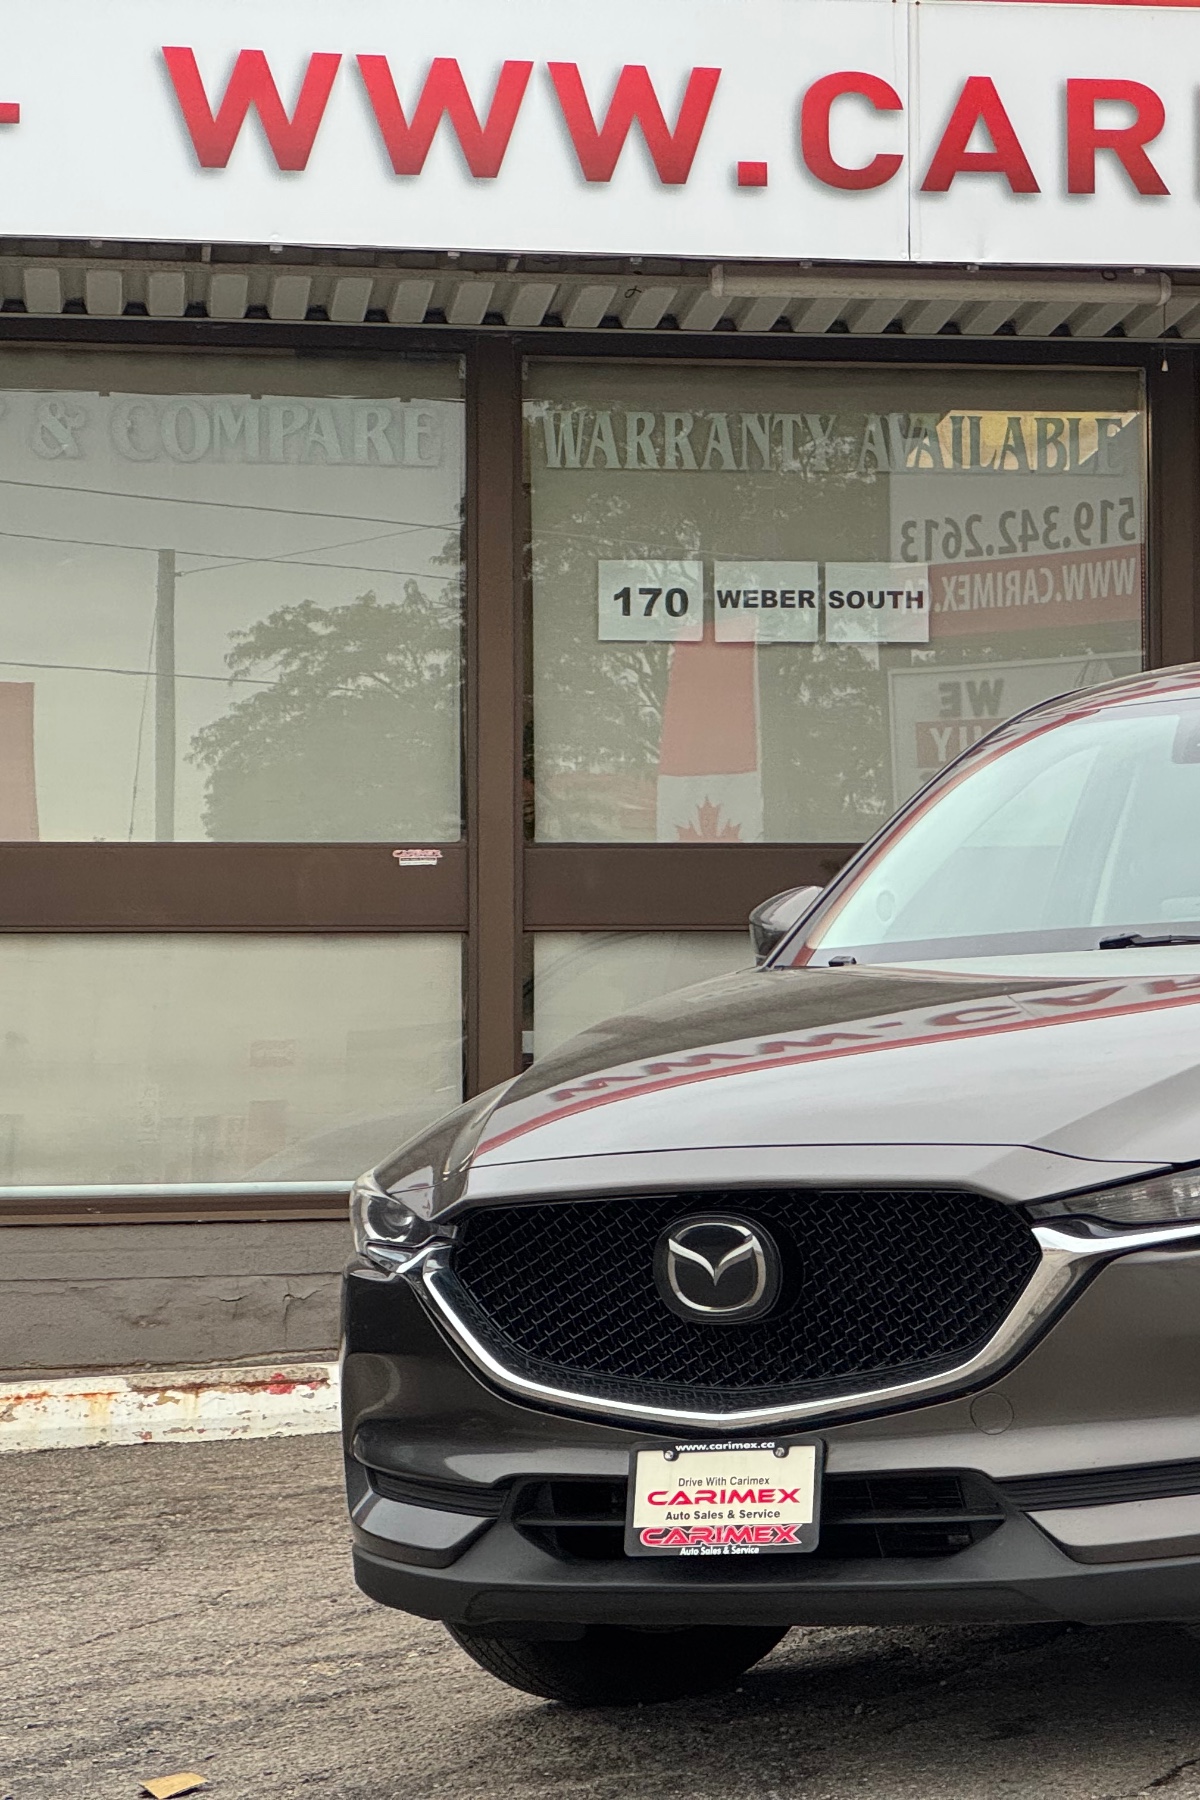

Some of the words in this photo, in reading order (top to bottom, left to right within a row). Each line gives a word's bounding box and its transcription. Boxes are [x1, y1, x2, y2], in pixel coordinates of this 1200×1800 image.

[110, 398, 442, 467] COMPARE
[543, 409, 838, 471] WARRANTY
[858, 411, 1124, 475] AVAILABLE
[613, 587, 690, 618] 170
[716, 589, 817, 609] WEBER
[828, 589, 925, 610] SOUTH
[675, 1441, 775, 1452] www.carimex.ca
[678, 1476, 703, 1487] Drive
[706, 1476, 727, 1487] With
[730, 1475, 770, 1486] Carimex
[647, 1488, 801, 1505] CARIMEX
[665, 1511, 691, 1521] Auto
[694, 1510, 724, 1520] Sales
[727, 1511, 735, 1519] &
[739, 1509, 781, 1519] Service
[640, 1524, 802, 1546] CARIMEX
[680, 1547, 699, 1555] Auto
[701, 1546, 722, 1556] Sales
[724, 1547, 730, 1555] &
[733, 1546, 760, 1555] Service
